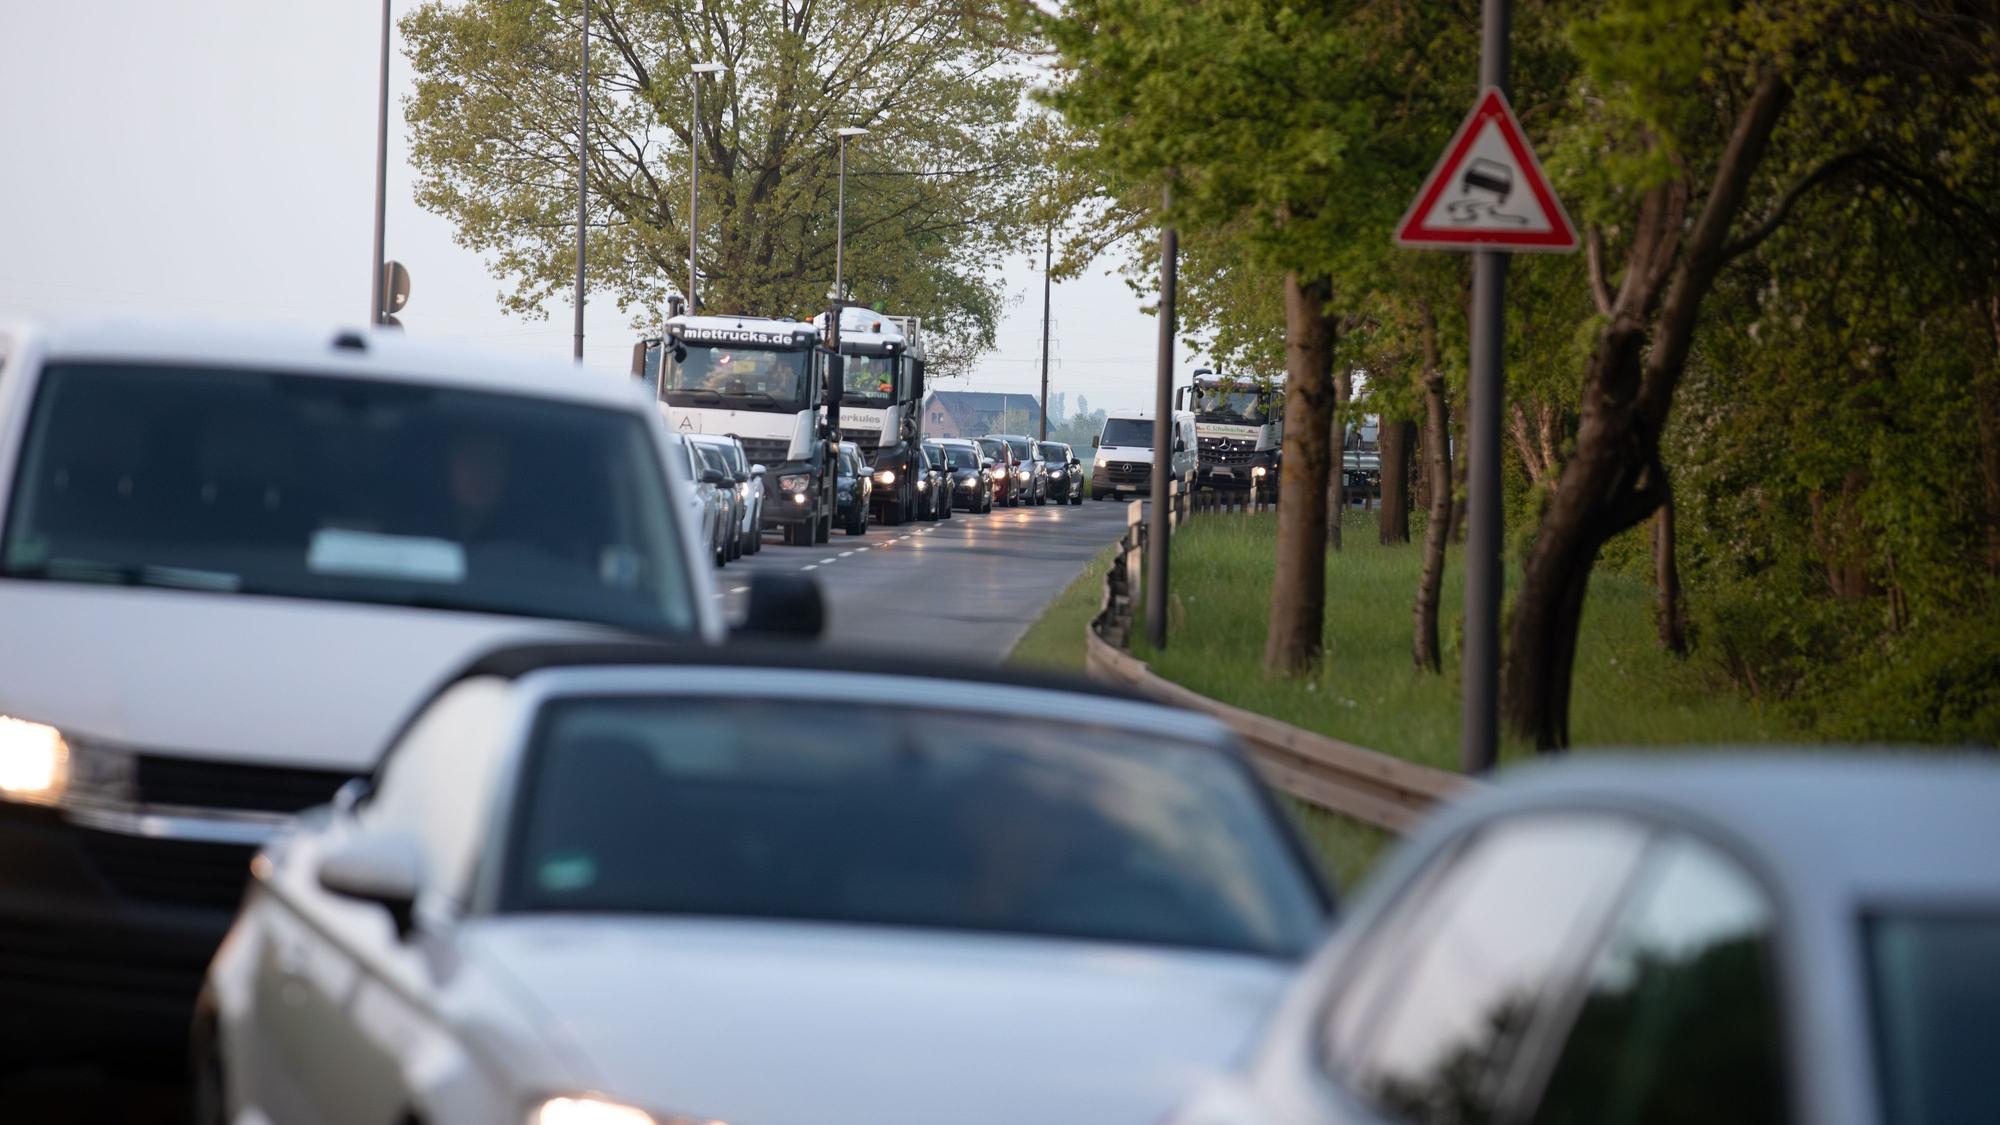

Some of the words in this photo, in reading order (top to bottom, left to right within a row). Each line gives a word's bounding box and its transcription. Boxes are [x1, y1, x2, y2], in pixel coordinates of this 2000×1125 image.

[683, 328, 793, 345] miettrucks.de
[679, 415, 693, 430] A
[840, 413, 881, 423] erkules
